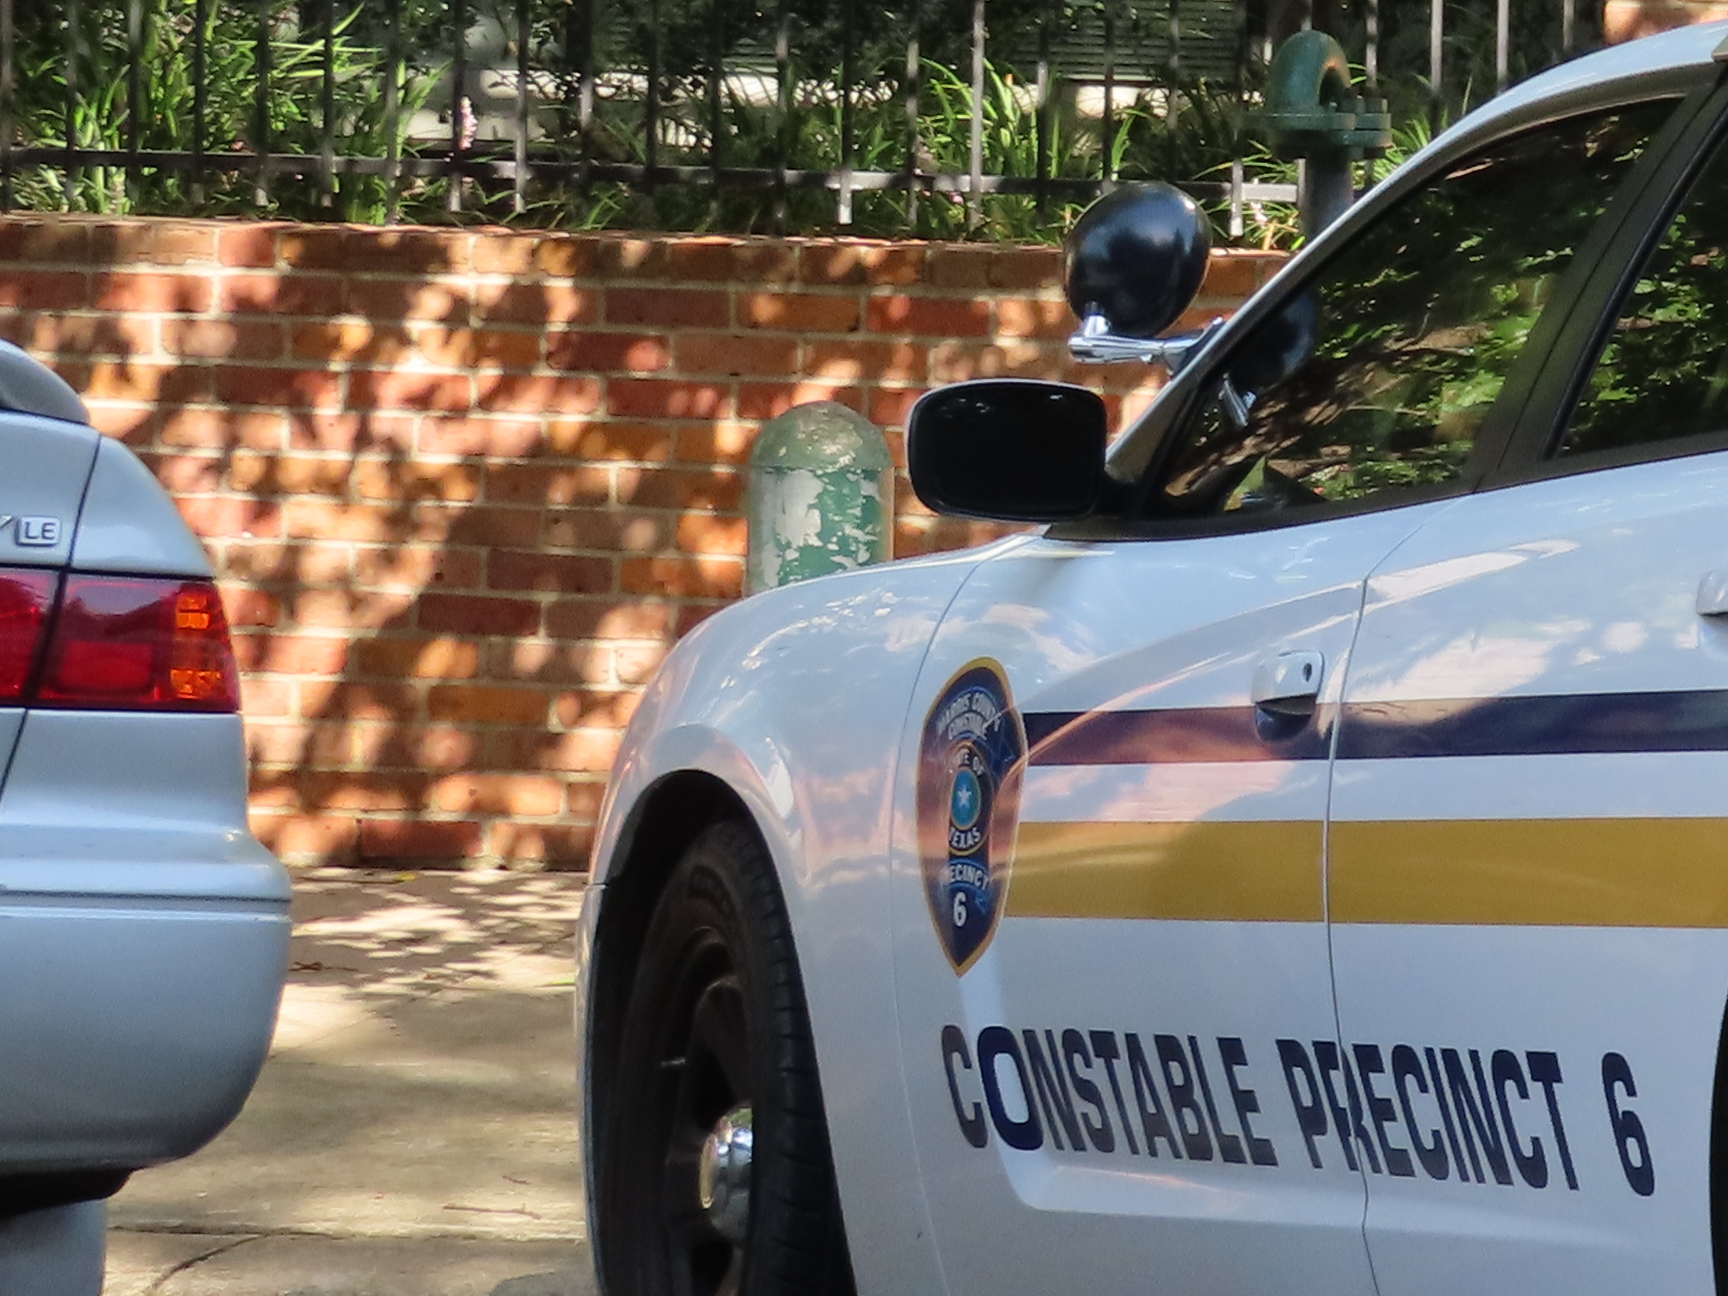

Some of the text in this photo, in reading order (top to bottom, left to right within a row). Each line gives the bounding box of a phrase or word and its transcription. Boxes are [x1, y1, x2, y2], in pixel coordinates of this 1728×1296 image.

[24, 520, 57, 540] LE
[953, 891, 968, 927] 6
[940, 1024, 1655, 1197] CONSTABLE PRECINCT 6
